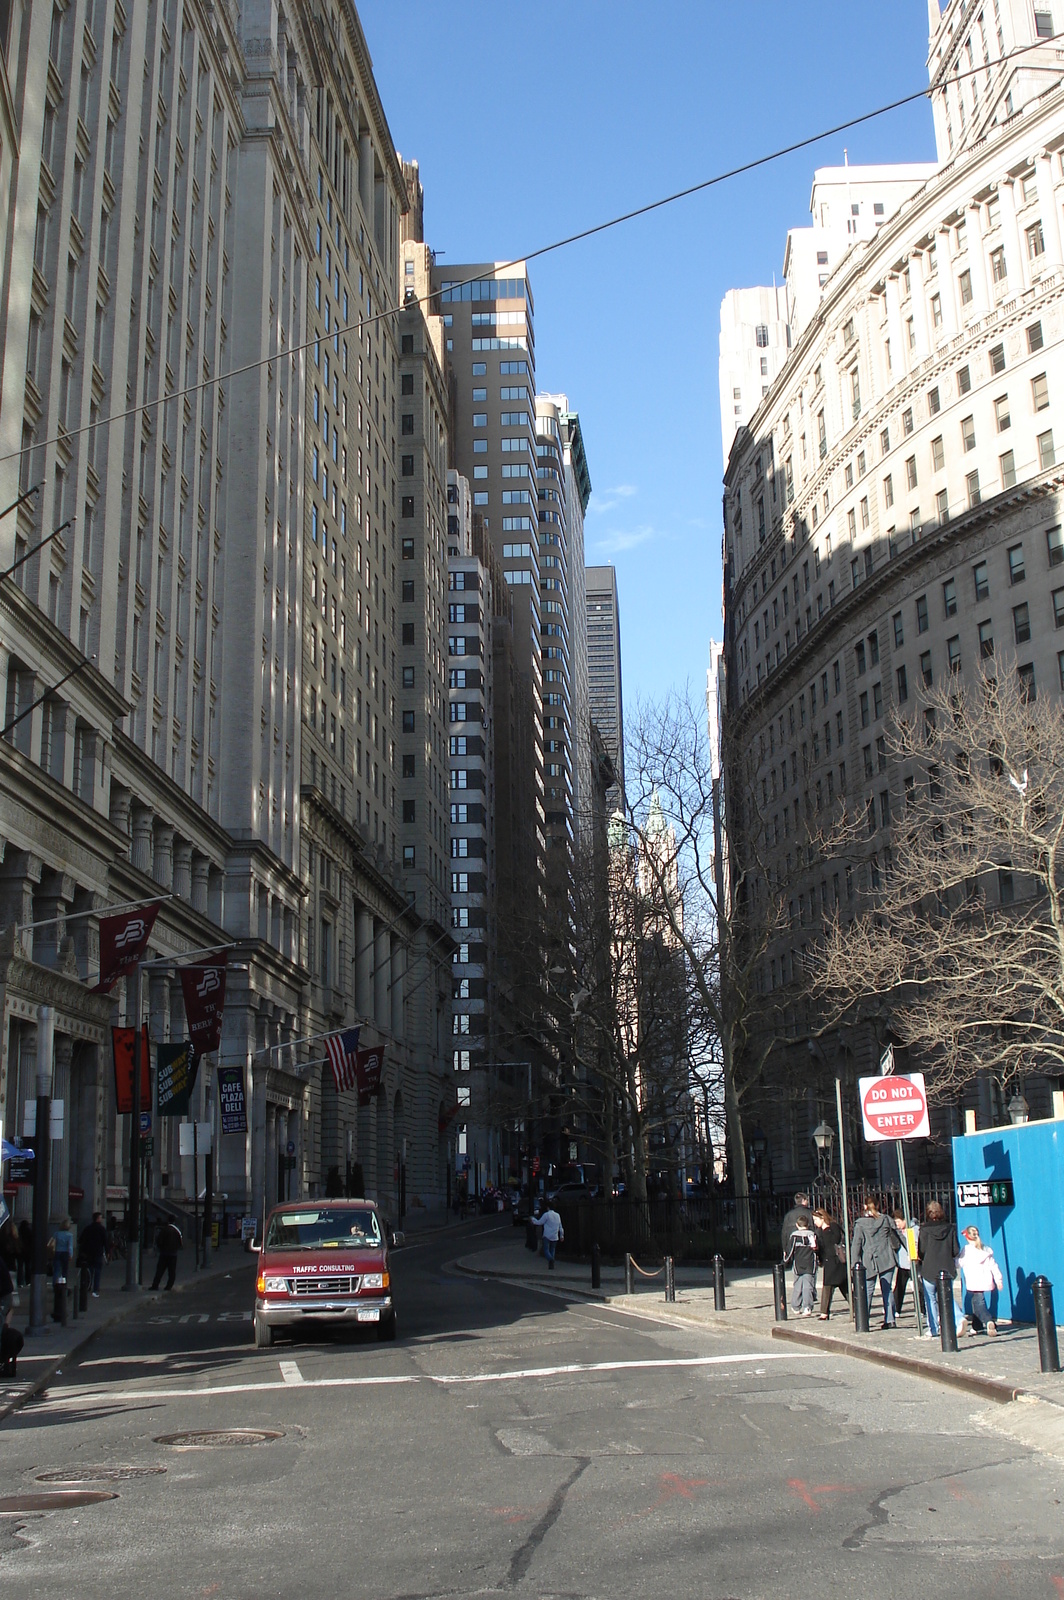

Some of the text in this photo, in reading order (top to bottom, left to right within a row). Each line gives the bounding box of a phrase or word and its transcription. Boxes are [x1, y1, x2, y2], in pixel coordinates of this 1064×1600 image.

[158, 1051, 188, 1082] SUBWAY
[158, 1065, 188, 1094] SUBWAY
[158, 1076, 188, 1107] SUBWAY
[222, 1082, 241, 1093] CAFE
[871, 1087, 913, 1100] DO NOT
[221, 1092, 244, 1103] PLAZA
[225, 1102, 242, 1113] DELI
[877, 1114, 914, 1127] ENTER
[293, 1265, 317, 1273] TRAFFIC
